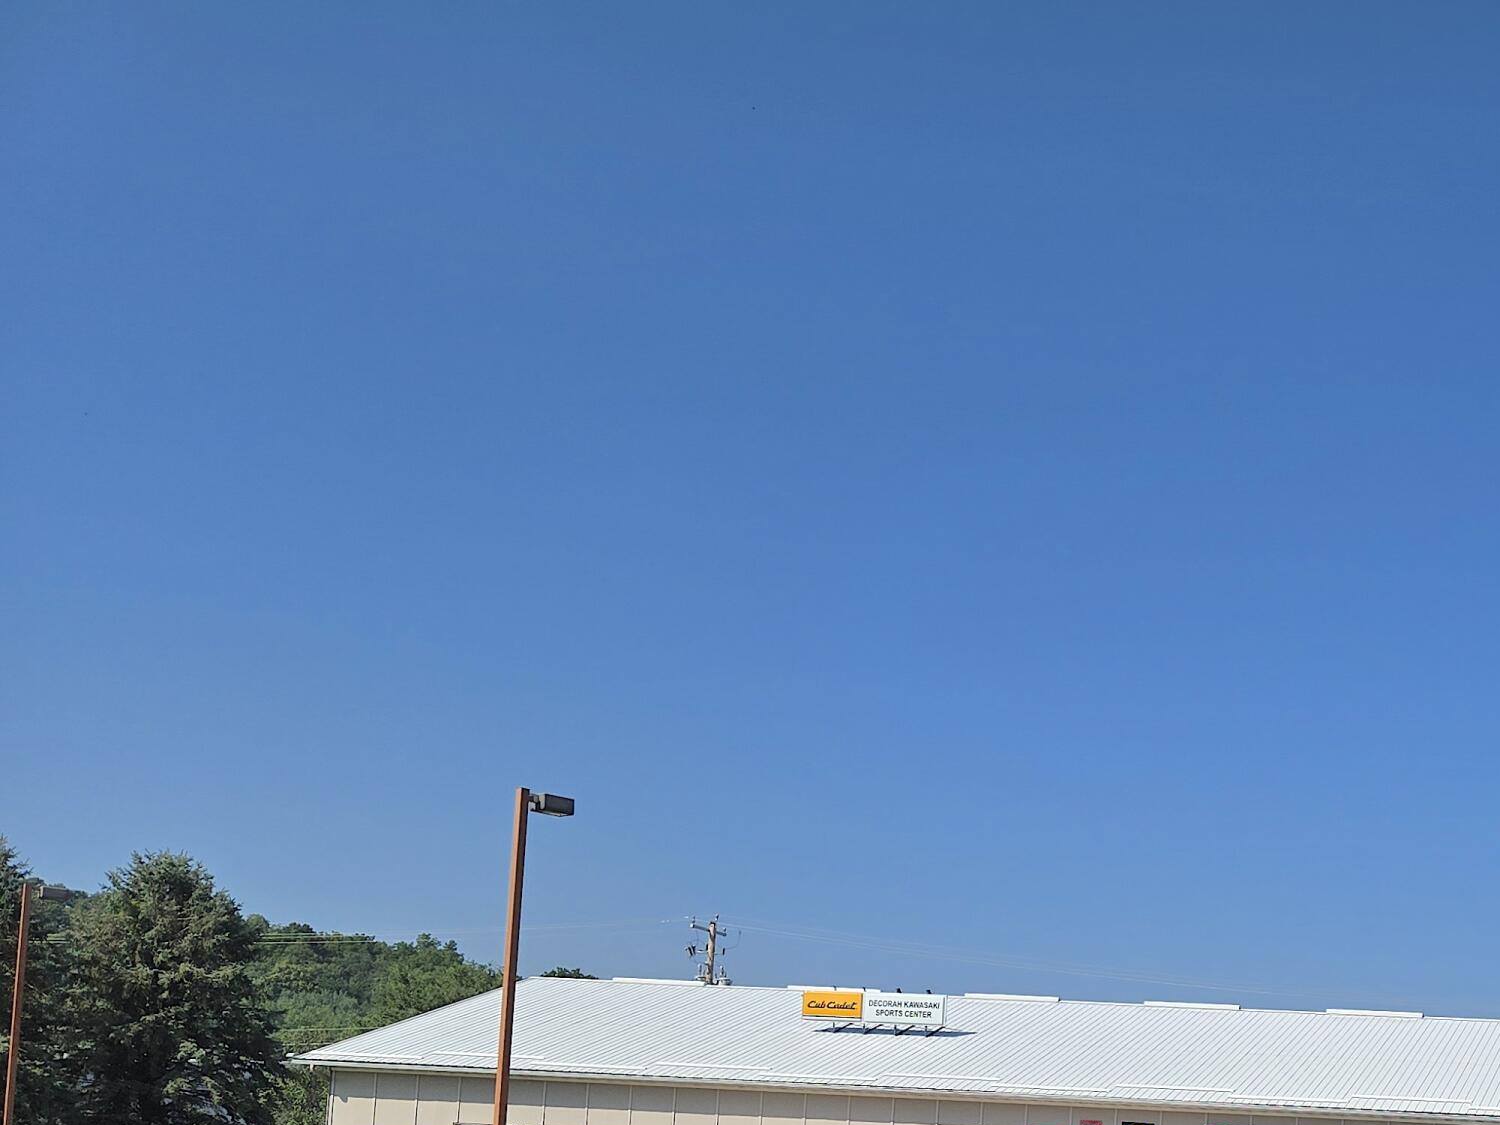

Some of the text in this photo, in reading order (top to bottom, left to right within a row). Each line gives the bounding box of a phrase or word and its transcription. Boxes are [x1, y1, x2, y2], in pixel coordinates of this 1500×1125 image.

[807, 1000, 857, 1010] Cub Cadet
[868, 1000, 940, 1010] DECORAH KAWASAKI
[875, 1009, 931, 1018] SPORTS CENTER
